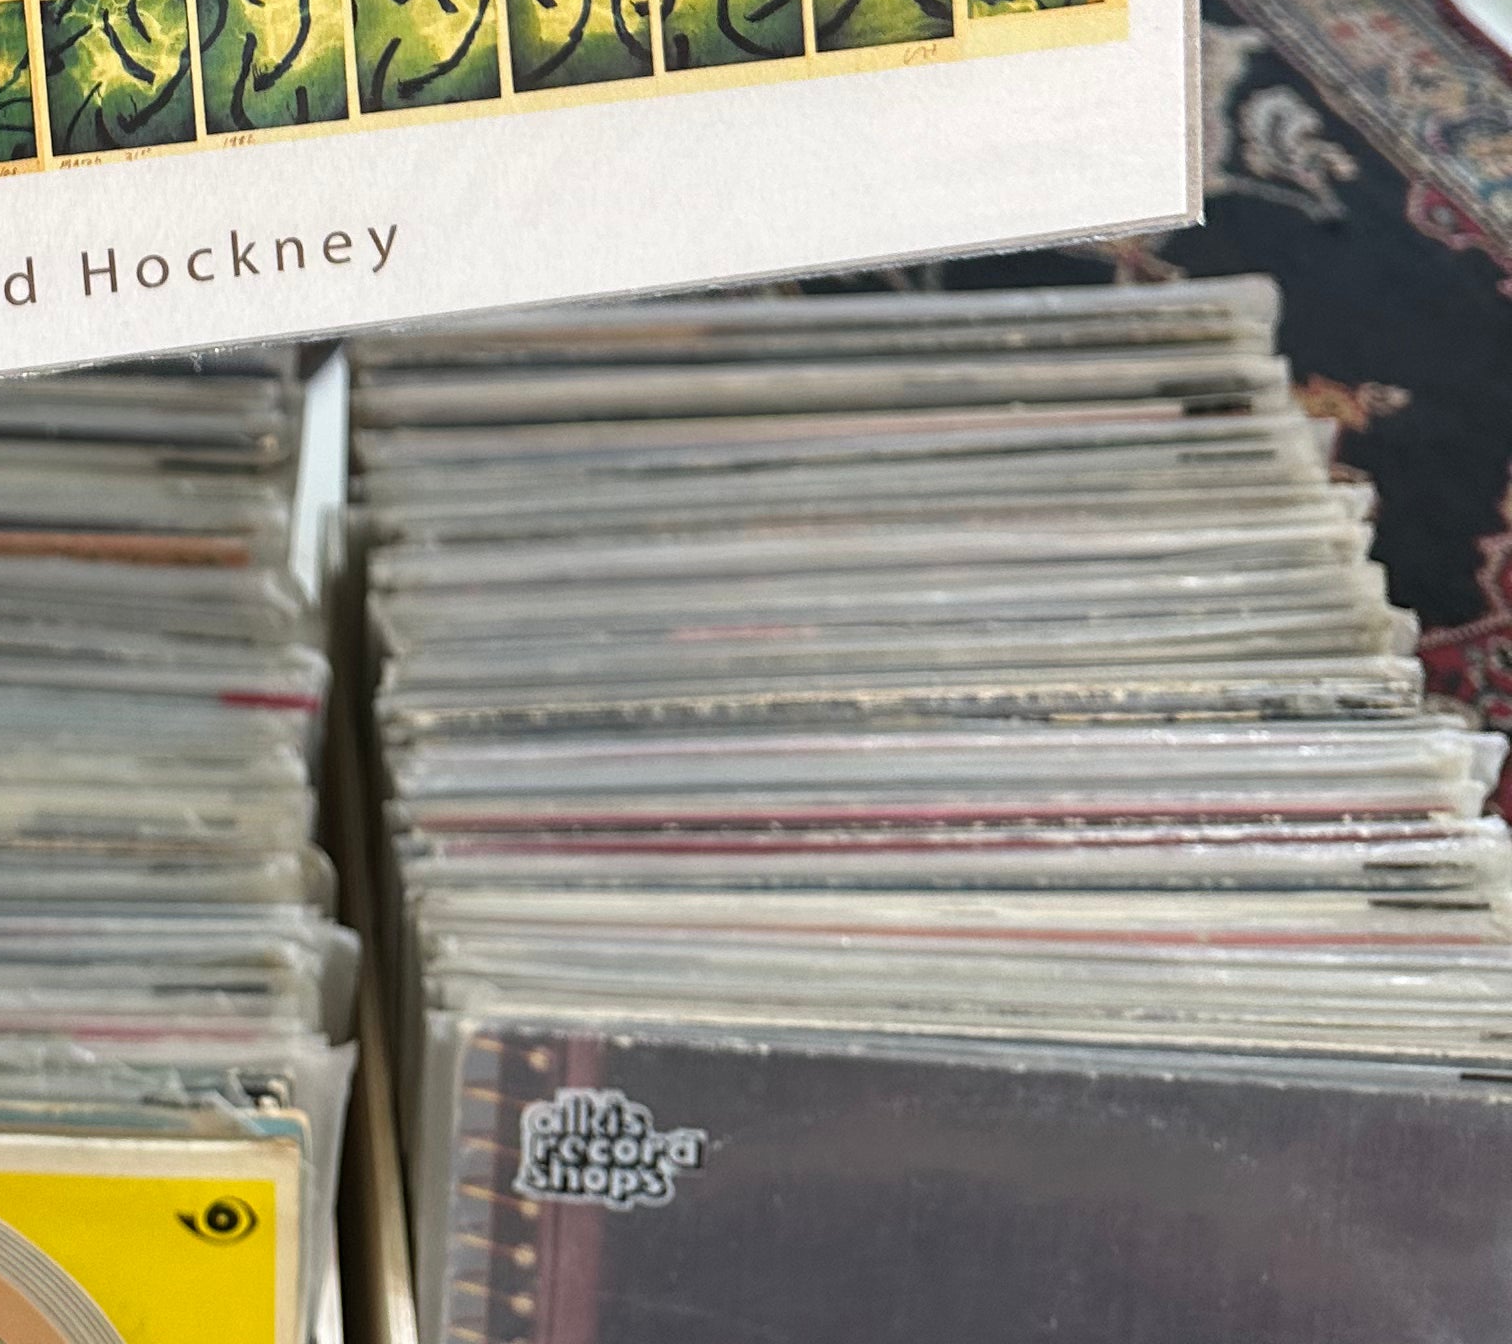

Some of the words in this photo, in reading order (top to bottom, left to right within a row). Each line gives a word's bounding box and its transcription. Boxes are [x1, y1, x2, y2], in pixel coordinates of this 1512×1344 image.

[80, 223, 398, 296] Hockney
[534, 1131, 702, 1168] record
[526, 1161, 666, 1200] shops
